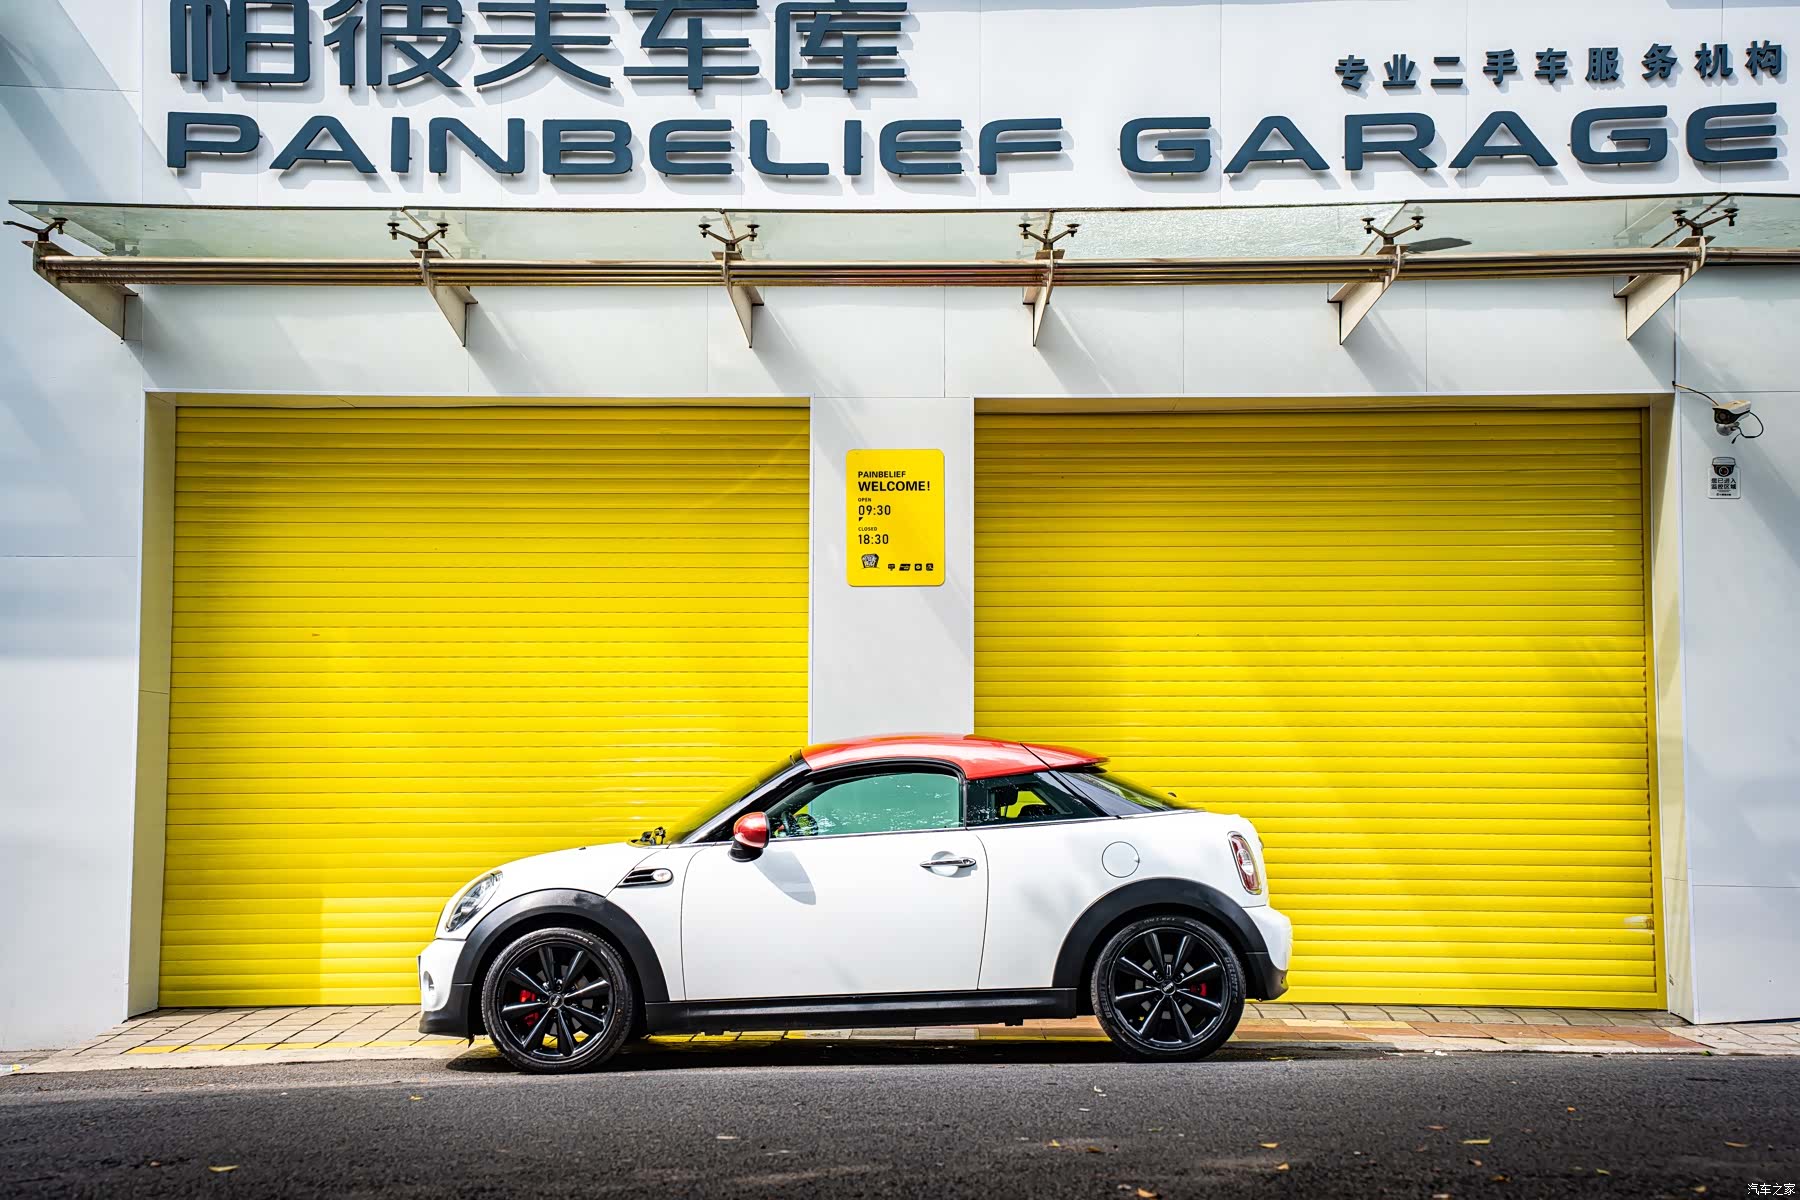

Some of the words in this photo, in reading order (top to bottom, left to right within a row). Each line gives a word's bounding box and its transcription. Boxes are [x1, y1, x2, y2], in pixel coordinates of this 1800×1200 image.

[1335, 40, 1782, 90] 专业二手车服务机构
[167, 111, 1062, 176] PAINBELIEF
[1119, 102, 1778, 174] GARAGE
[858, 481, 930, 491] WELCOME!
[858, 505, 891, 515] 09:30
[858, 534, 889, 544] 18:30
